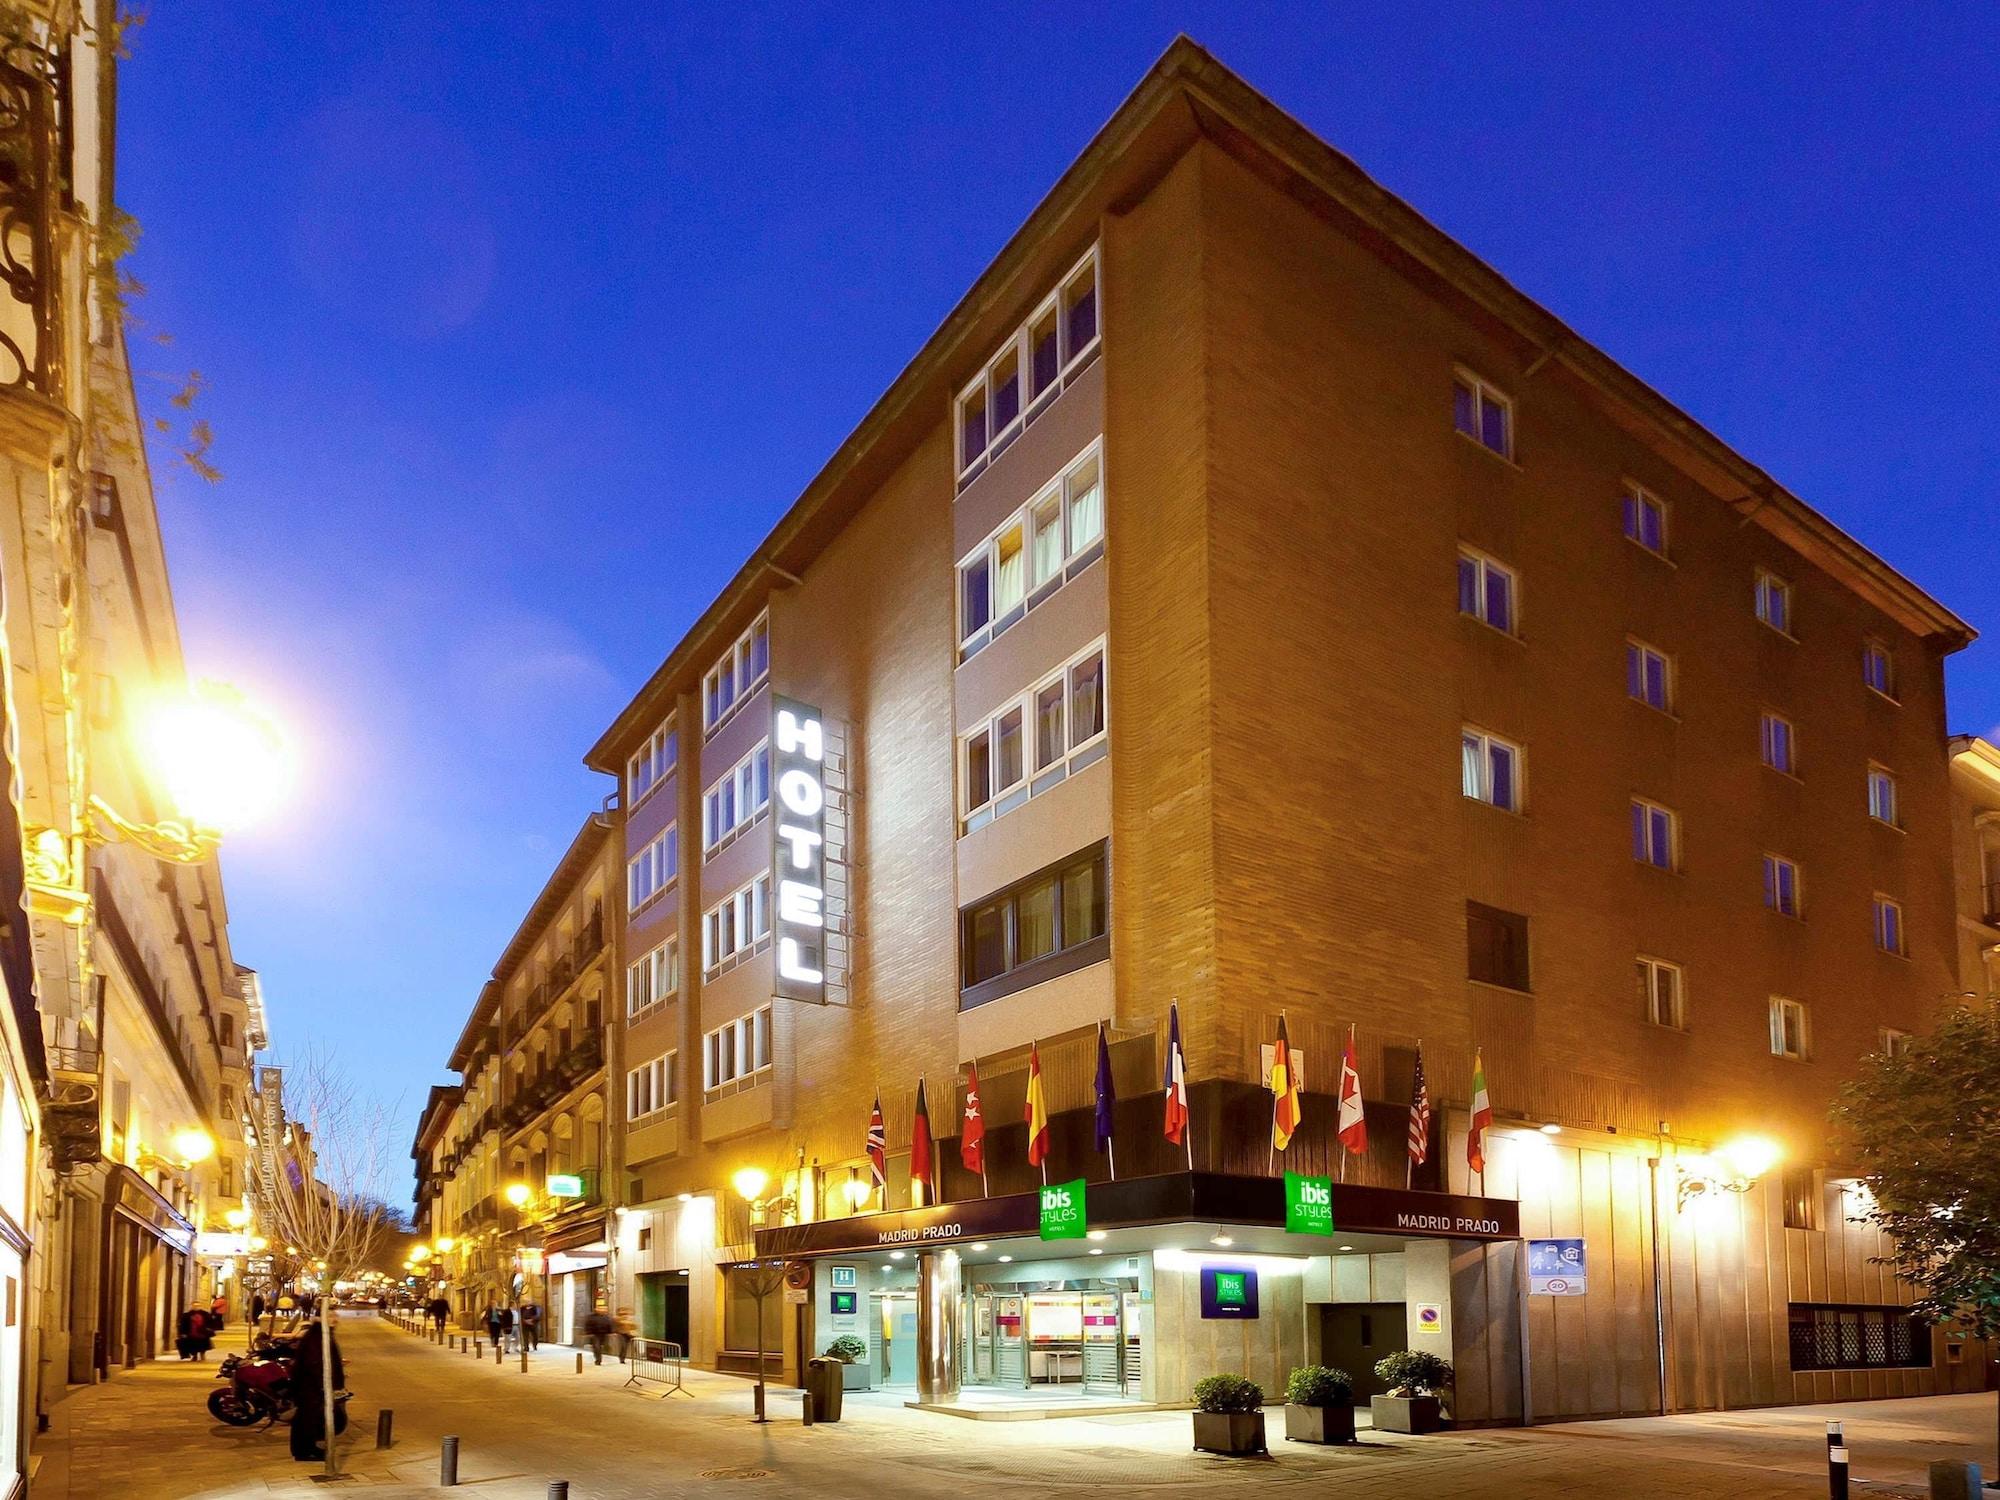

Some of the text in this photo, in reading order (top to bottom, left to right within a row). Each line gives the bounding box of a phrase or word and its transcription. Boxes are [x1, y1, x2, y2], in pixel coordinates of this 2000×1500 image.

[778, 710, 823, 983] HOTEL
[1042, 1188, 1071, 1210] ibis
[1300, 1181, 1329, 1205] ibis
[878, 1223, 961, 1243] MADRID PRADO
[1398, 1213, 1499, 1233] MADRID PRADO
[1222, 1278, 1240, 1289] ibis
